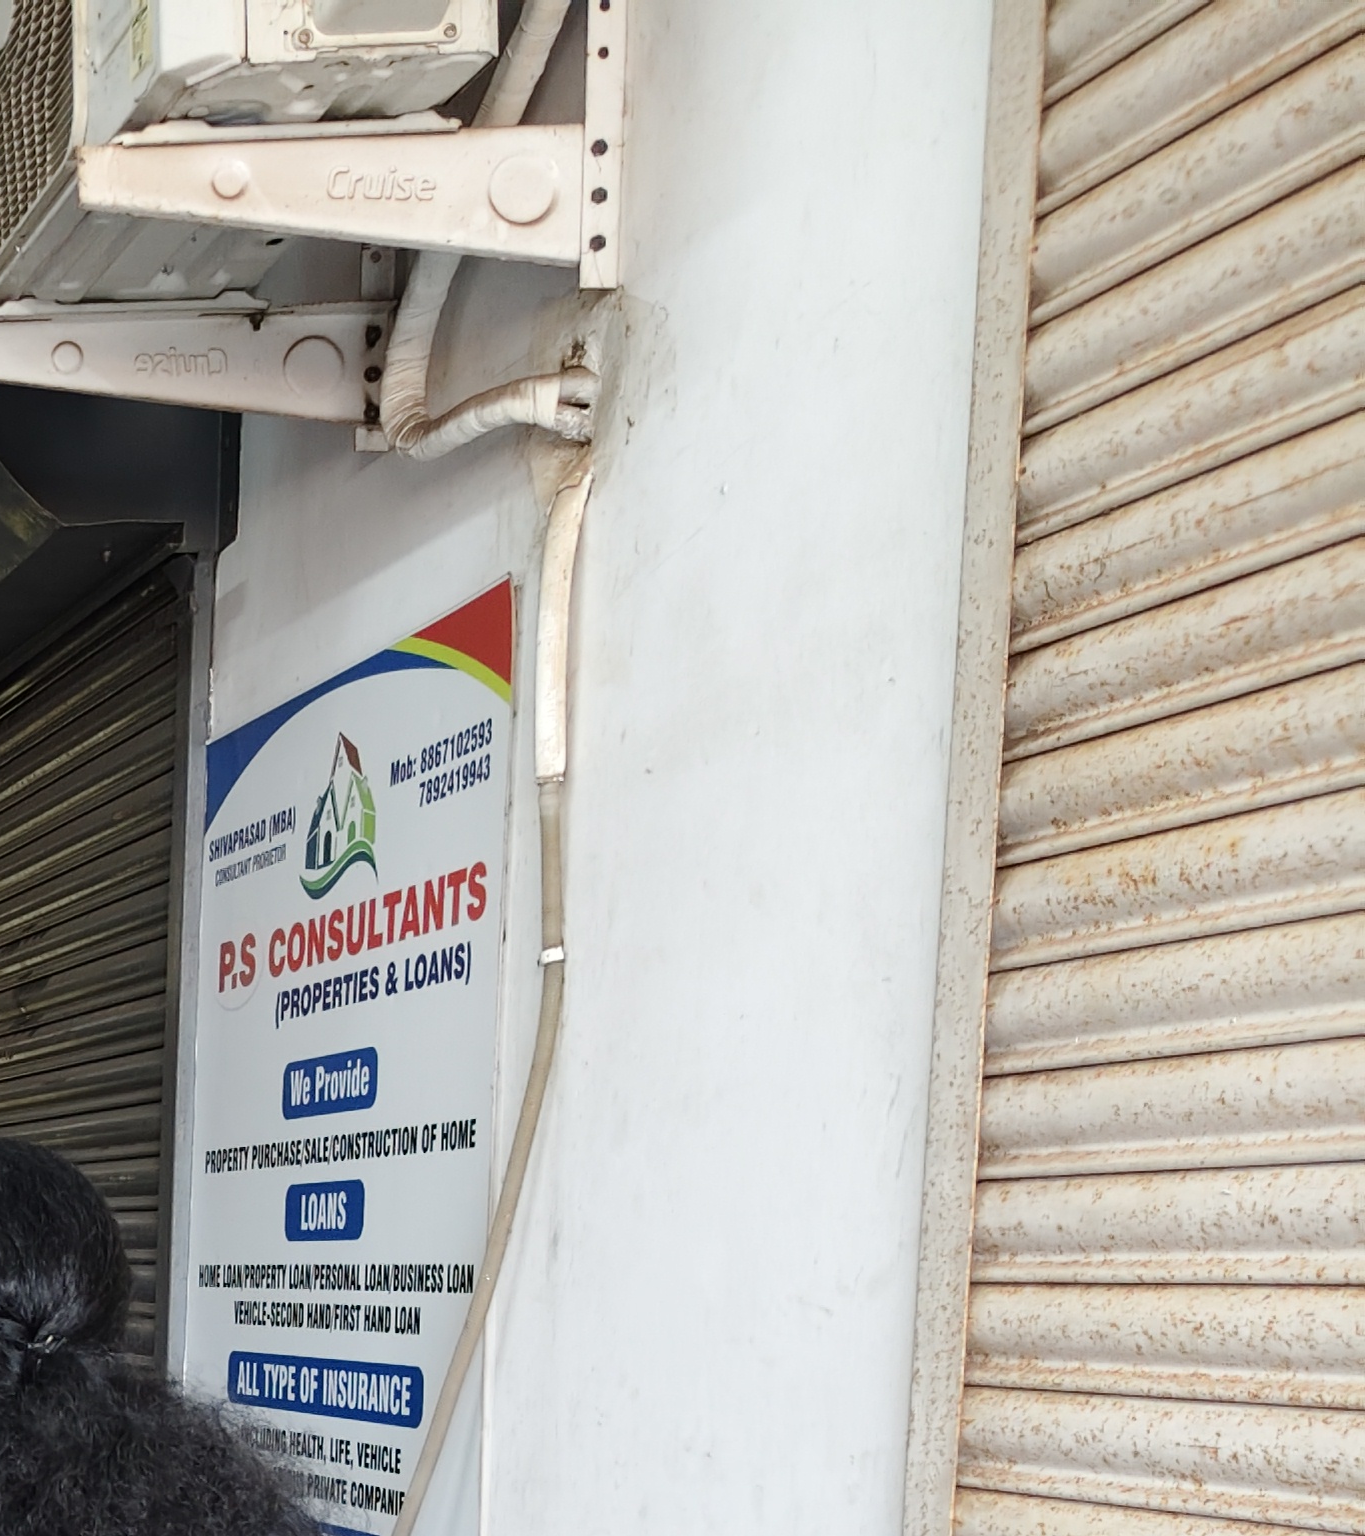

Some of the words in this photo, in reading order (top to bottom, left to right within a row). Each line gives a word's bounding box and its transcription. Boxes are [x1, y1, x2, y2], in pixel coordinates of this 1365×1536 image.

[327, 165, 437, 201] Cruise
[390, 754, 417, 788] Mob:
[420, 718, 493, 775] 8867102593
[419, 754, 491, 807] 7892419943
[209, 819, 266, 862] SHIVAPRASAD
[269, 806, 296, 844] (MBA)
[215, 851, 251, 887] CONSULTANT
[219, 932, 256, 993] P.S
[269, 861, 487, 978] CONSULTANTS
[275, 966, 380, 1029] (PROPERTIES
[385, 961, 399, 996] &
[404, 940, 472, 992] LOANS)
[290, 1069, 310, 1107] We
[314, 1058, 370, 1103] Provide
[204, 1146, 250, 1174] PROPERTY
[251, 1125, 418, 1169] PURCHASE/SALE/CONSTRUCTION
[422, 1123, 437, 1153] OF
[441, 1118, 477, 1151] HOME
[300, 1190, 347, 1231] LOANS
[198, 1264, 221, 1288] HOME
[222, 1264, 287, 1291] LOAN/PROPERTY
[289, 1264, 361, 1292] LOAN/PERSONAL
[365, 1264, 444, 1294] LOAN/BUSINESS
[447, 1264, 475, 1294] LOAN
[234, 1300, 305, 1328] VEHICLE-SECOND
[307, 1302, 361, 1333] HAND/FIRST
[364, 1305, 391, 1334] HAND
[394, 1306, 421, 1335] LOAN
[236, 1360, 260, 1397] ALL
[262, 1363, 296, 1401] TYPE
[299, 1366, 319, 1404] OF
[322, 1368, 412, 1416] INSURANCE
[289, 1431, 327, 1465] HEALTH,
[329, 1438, 354, 1470] LIFE,
[356, 1441, 401, 1475] VEHICLE
[307, 1473, 347, 1505] PRIVATE
[350, 1481, 405, 1517] COMPANIE
